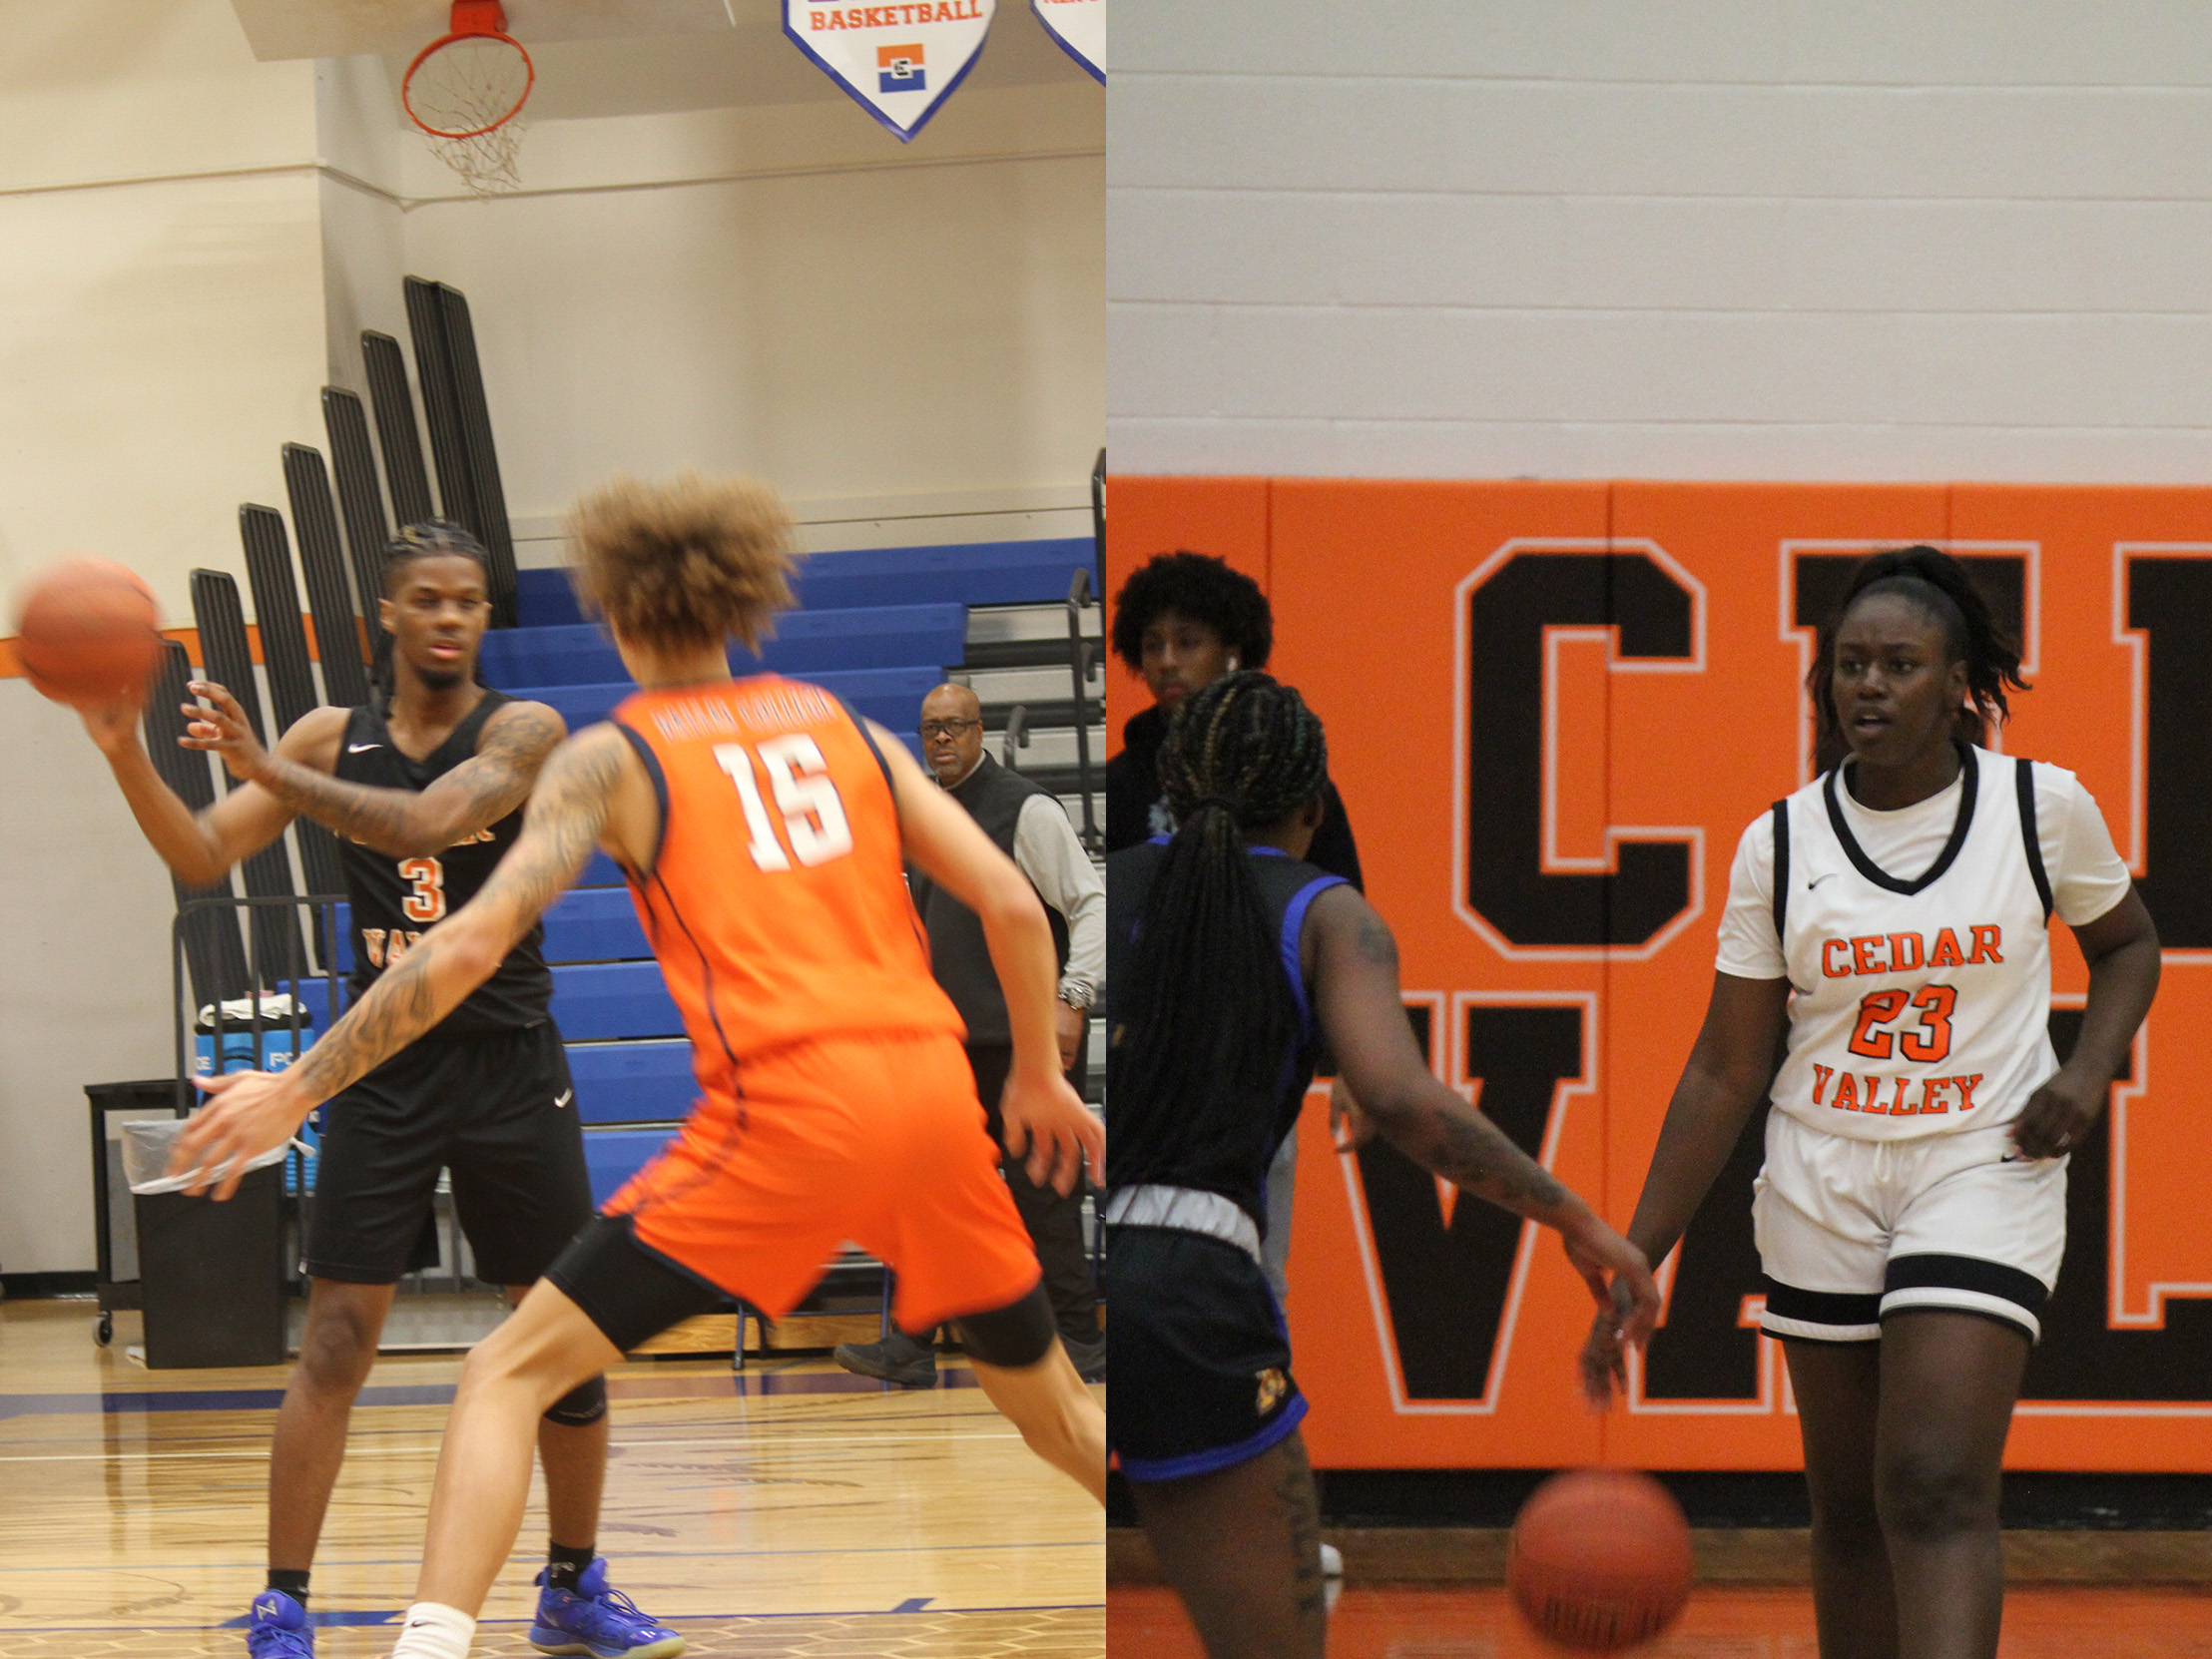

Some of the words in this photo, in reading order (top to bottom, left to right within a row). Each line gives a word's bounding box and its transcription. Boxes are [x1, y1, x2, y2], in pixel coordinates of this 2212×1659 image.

[810, 0, 982, 31] BASKETBALL
[397, 856, 447, 922] 3
[1822, 923, 2004, 978] CEDAR
[1848, 983, 1958, 1063] 23
[1812, 1063, 1984, 1116] VALLEY
